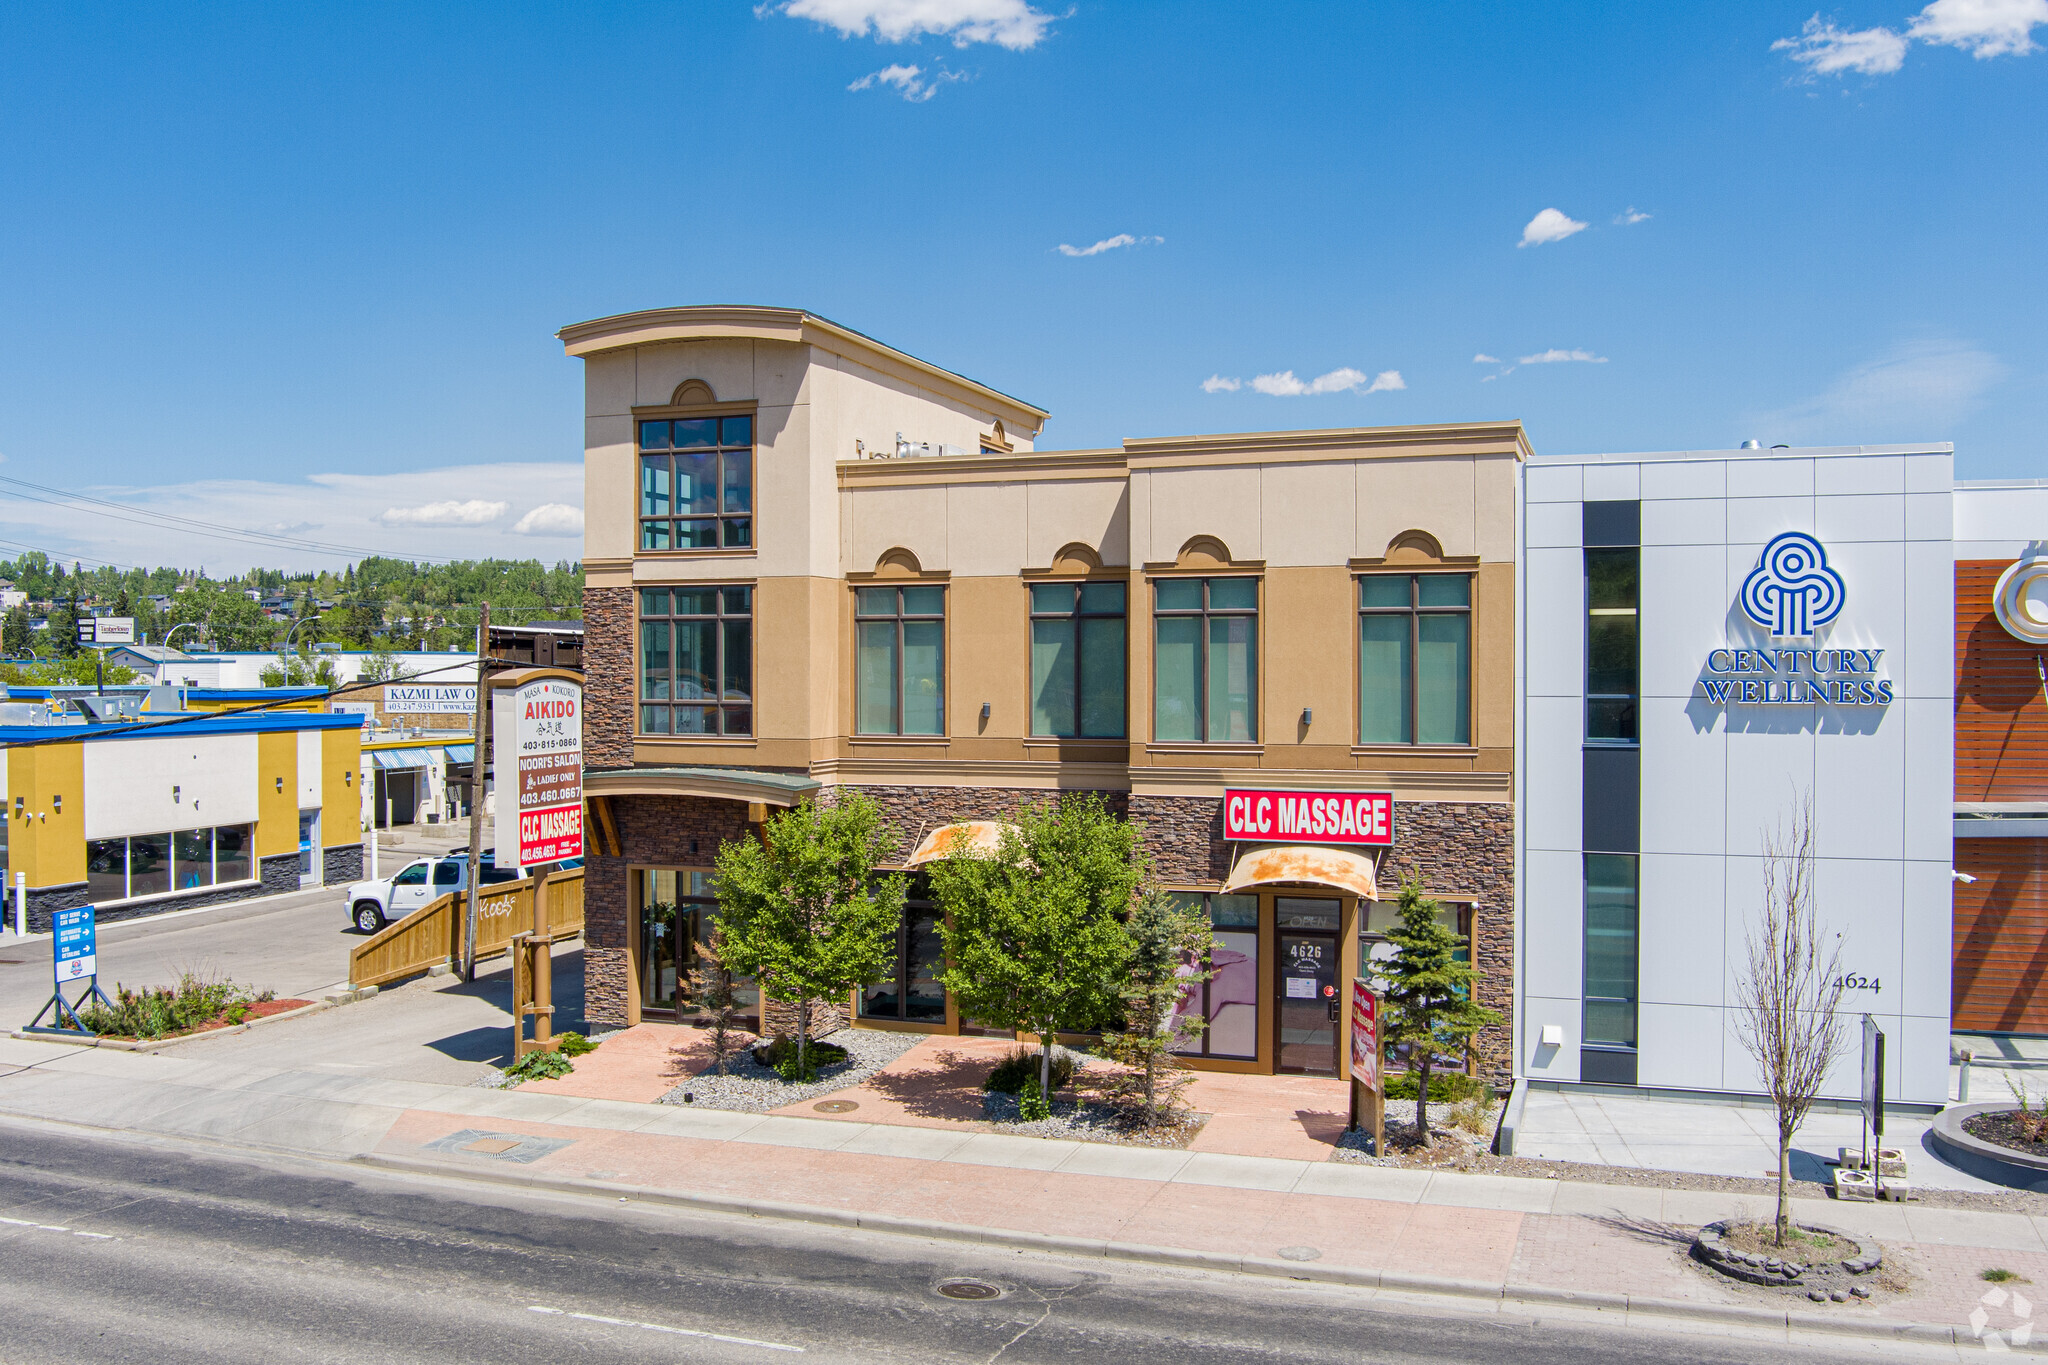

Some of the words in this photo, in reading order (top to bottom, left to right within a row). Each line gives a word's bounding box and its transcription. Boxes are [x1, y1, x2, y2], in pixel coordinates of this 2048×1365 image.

[1707, 649, 1885, 674] CENTURY
[390, 688, 430, 700] KAZMI
[435, 688, 461, 700] LAW
[524, 686, 541, 700] MASA
[552, 685, 575, 698] KOKORO
[1699, 680, 1894, 706] WELLNESS
[388, 702, 435, 711] 403.247.9331
[525, 700, 575, 720] AIKIDO
[520, 756, 553, 771] NOORI'S
[554, 753, 580, 767] SALON
[537, 774, 559, 785] LADIES
[560, 772, 576, 782] ONLY
[520, 787, 580, 804] 403.460.0667
[1229, 796, 1272, 833] CLC
[1278, 797, 1387, 836] MASSAGE
[521, 815, 539, 843] CLC
[541, 809, 580, 840] MASSAGE
[1290, 945, 1322, 958] 4626
[1832, 972, 1881, 994] 4624
